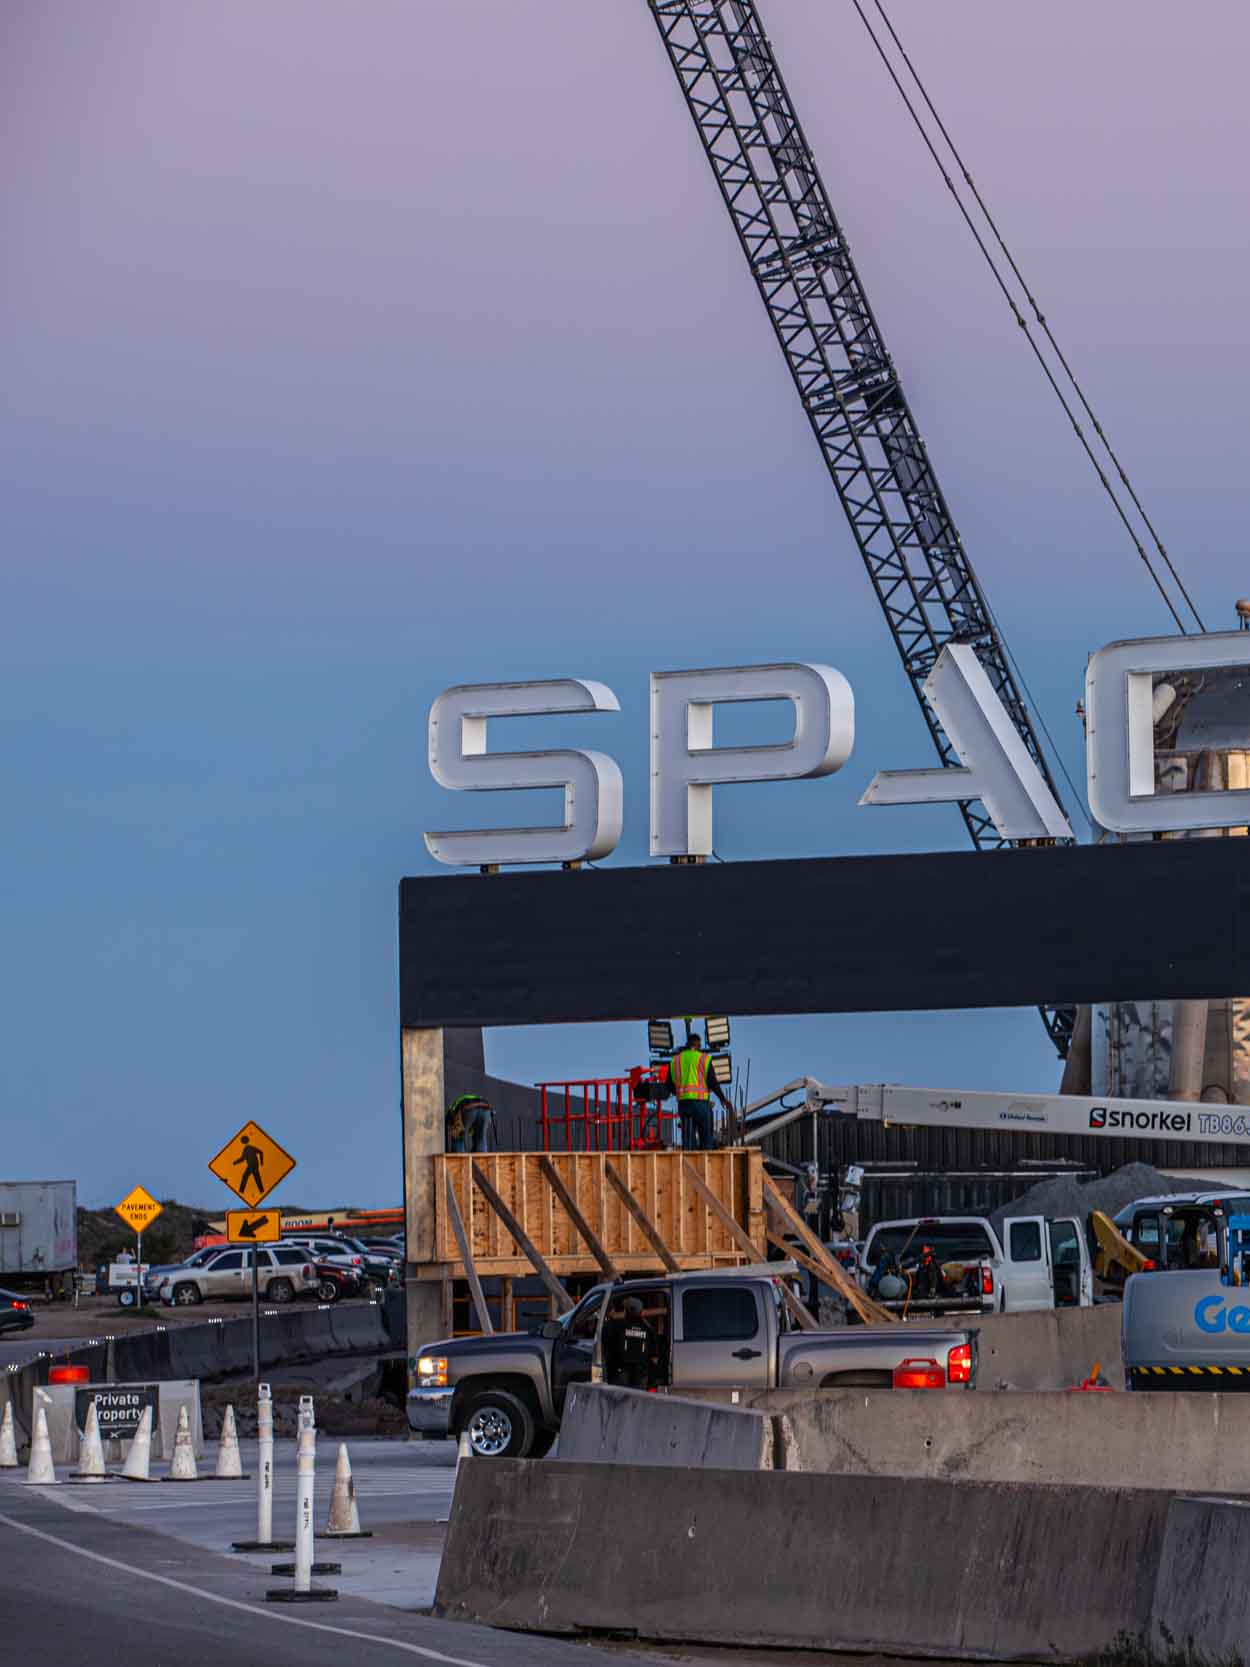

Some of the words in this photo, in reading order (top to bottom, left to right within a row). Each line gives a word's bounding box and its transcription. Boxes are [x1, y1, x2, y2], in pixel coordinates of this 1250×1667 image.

[1108, 1109, 1192, 1132] snorkel
[121, 1203, 156, 1211] PAVEMENT
[130, 1213, 147, 1221] ENDS
[95, 1392, 139, 1405] Private
[98, 1408, 143, 1421] roperty
